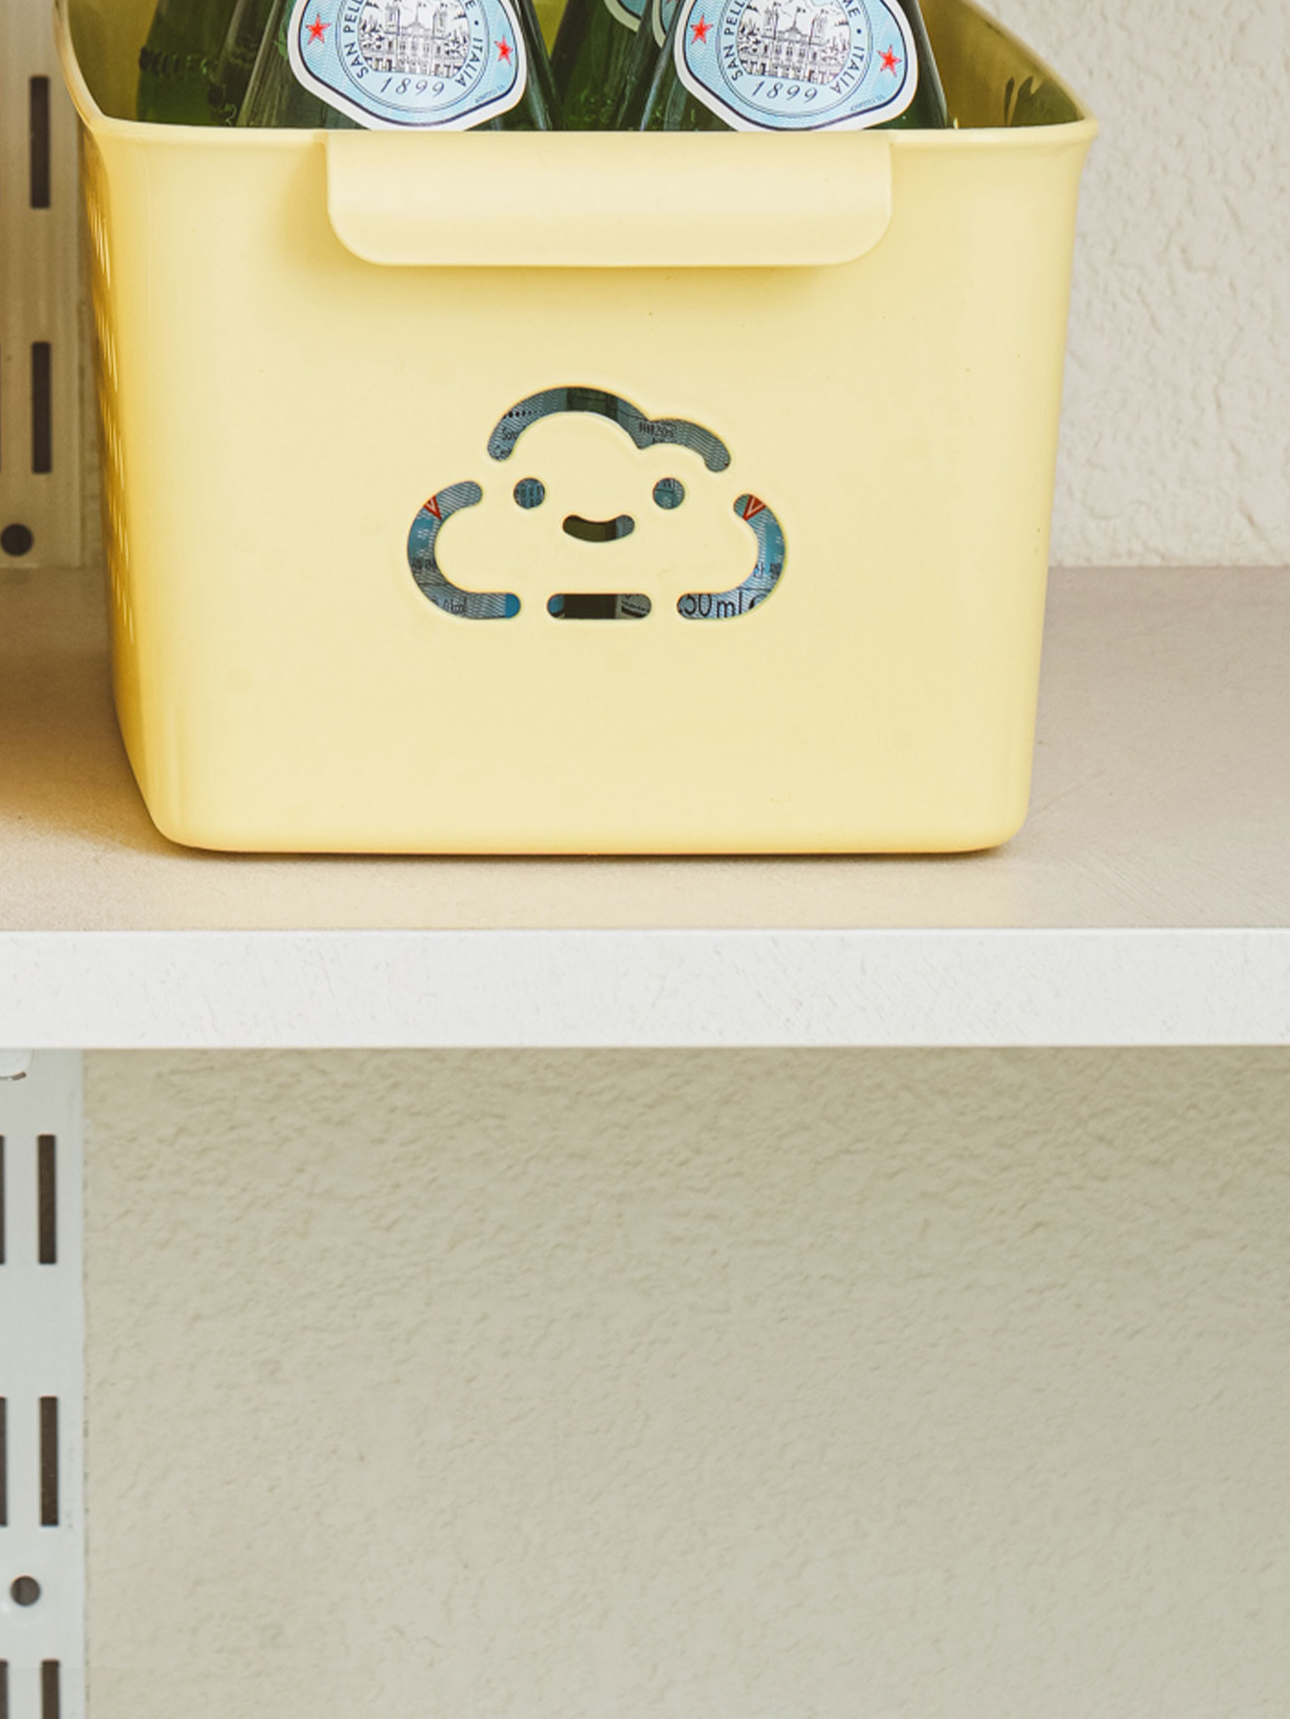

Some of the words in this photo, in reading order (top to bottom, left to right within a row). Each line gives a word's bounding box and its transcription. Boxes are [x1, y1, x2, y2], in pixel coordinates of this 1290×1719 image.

[343, 41, 370, 79] SAN
[454, 37, 484, 88] ITALIA
[721, 44, 744, 82] SAN
[830, 46, 865, 95] ITALIA
[379, 75, 446, 98] 1899
[751, 79, 818, 104] 1899
